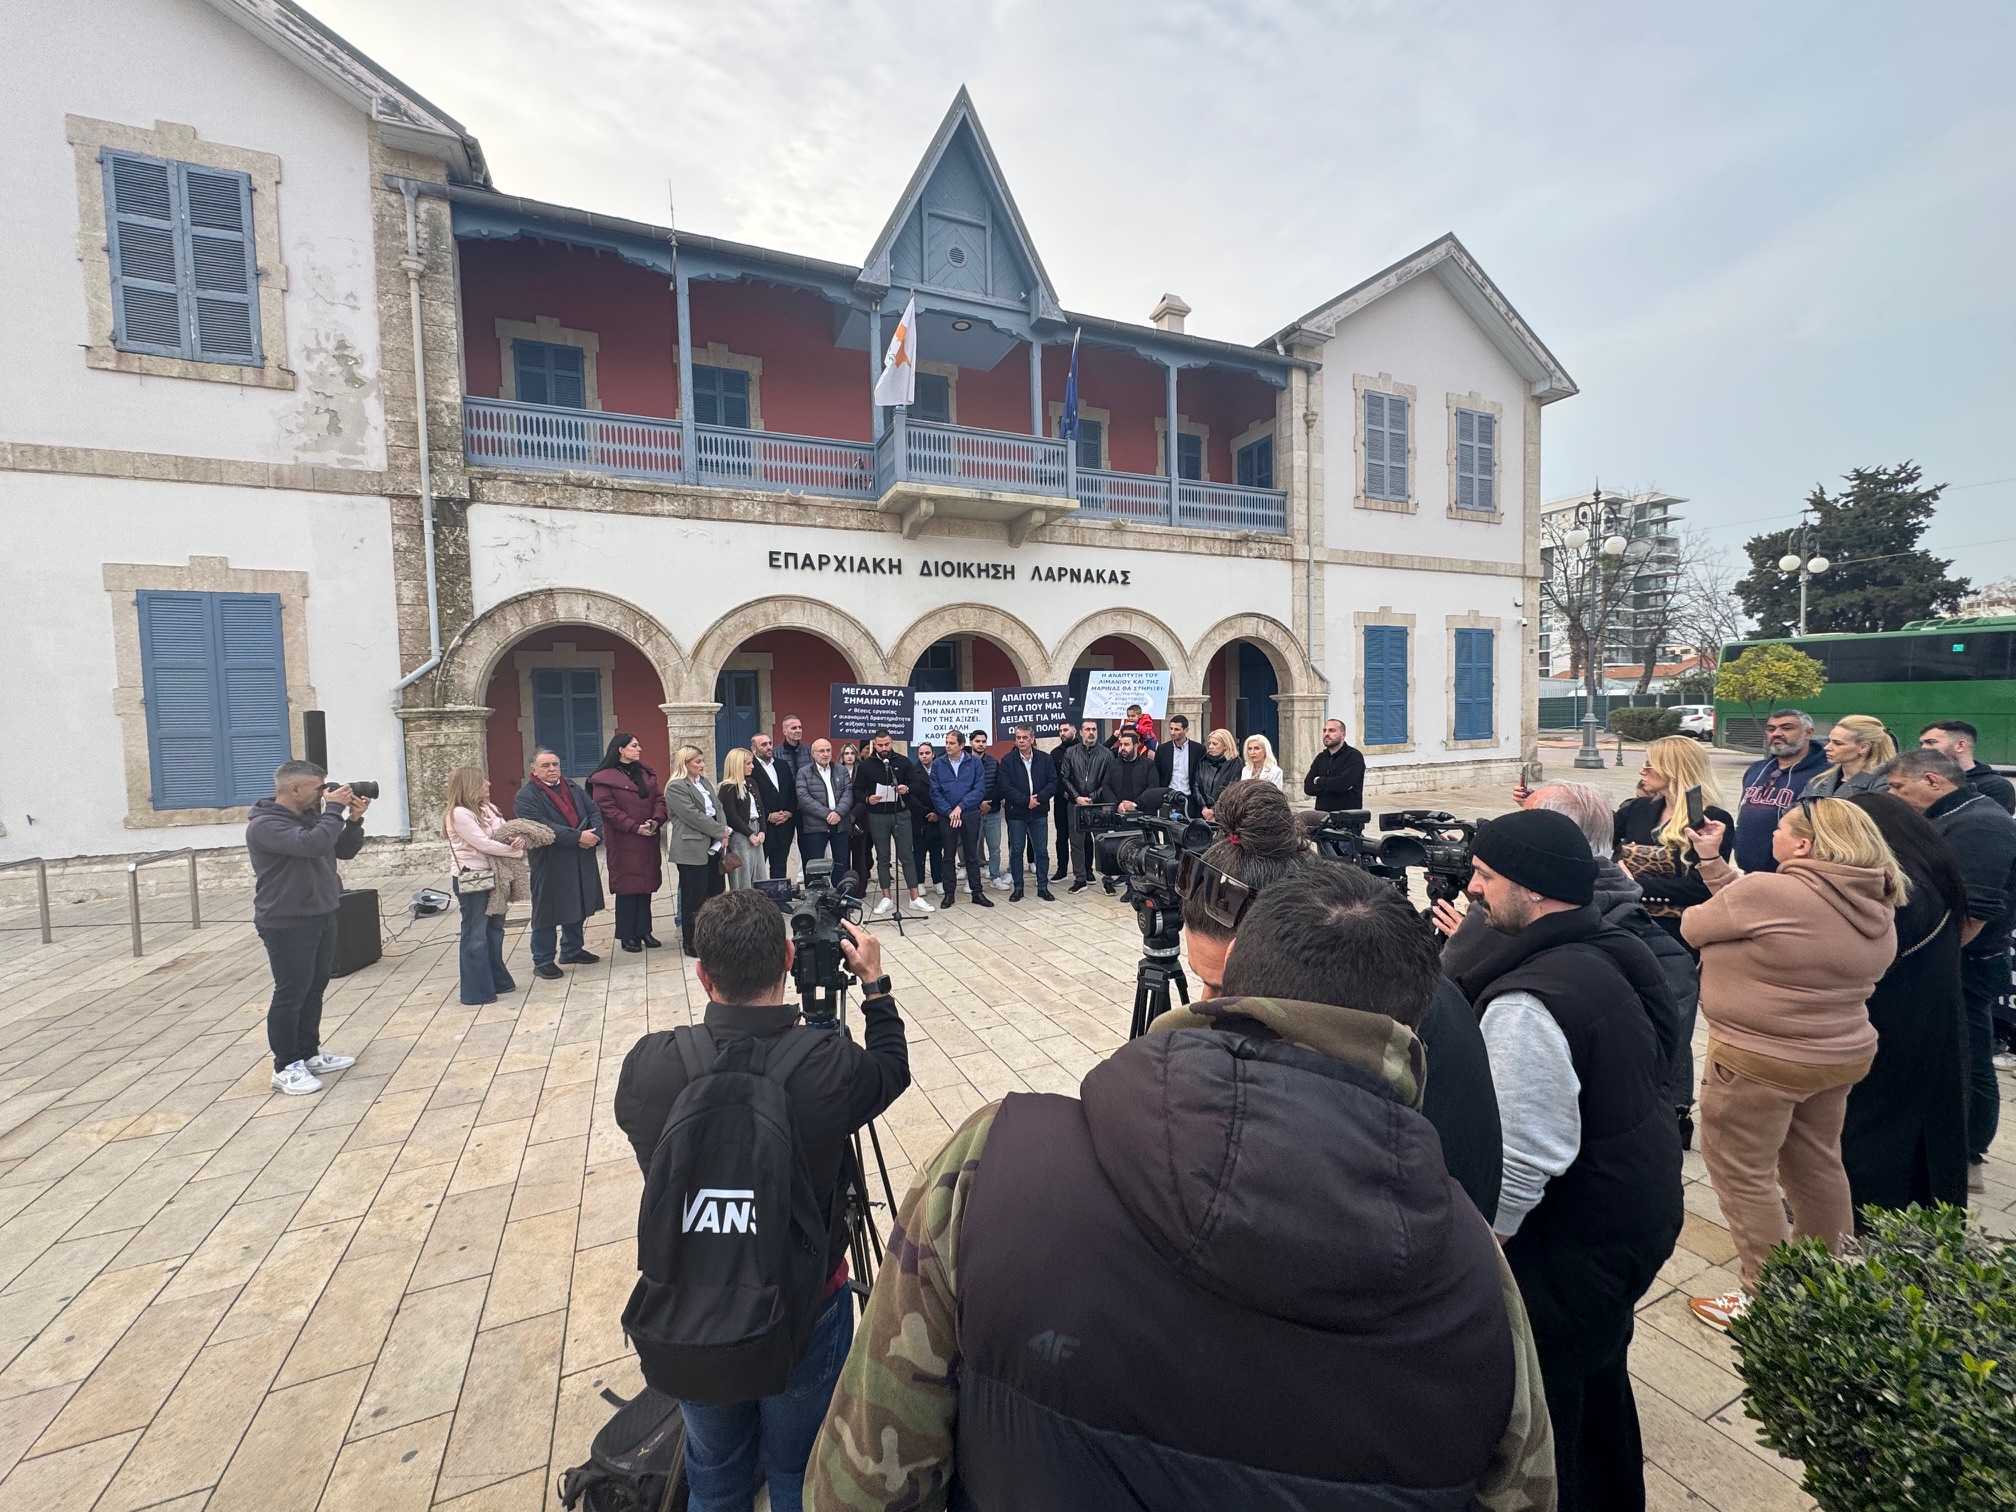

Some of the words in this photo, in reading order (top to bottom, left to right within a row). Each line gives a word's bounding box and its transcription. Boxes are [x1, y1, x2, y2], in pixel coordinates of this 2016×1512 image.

[768, 550, 902, 575] ΕΠΑΡΧΙΑΚΗ
[919, 560, 1016, 580] ΔΙΟΙΚΗΣΗ
[1030, 565, 1131, 585] ΛΑΡΝΑΚΑΣ
[842, 688, 880, 696] ΜΕΓΑΛΑ
[882, 690, 904, 698] ΕΡΓΑ
[1002, 692, 1050, 702] ΑΠΑΙΤΟΥΜΕ
[844, 697, 902, 706] ΣΗΜΑΙΝΟΥΝ:
[1002, 704, 1024, 712] ΕΡΓΑ
[1026, 703, 1043, 711] ΠΟΥ
[1045, 702, 1062, 710] ΜΑΣ
[1000, 714, 1034, 724] ΔΕΙΞΑΤΕ
[1036, 713, 1049, 722] ΓΙΑ
[1050, 712, 1066, 720] ΜΙΑ
[1036, 723, 1060, 732] ΠΟΛΗ
